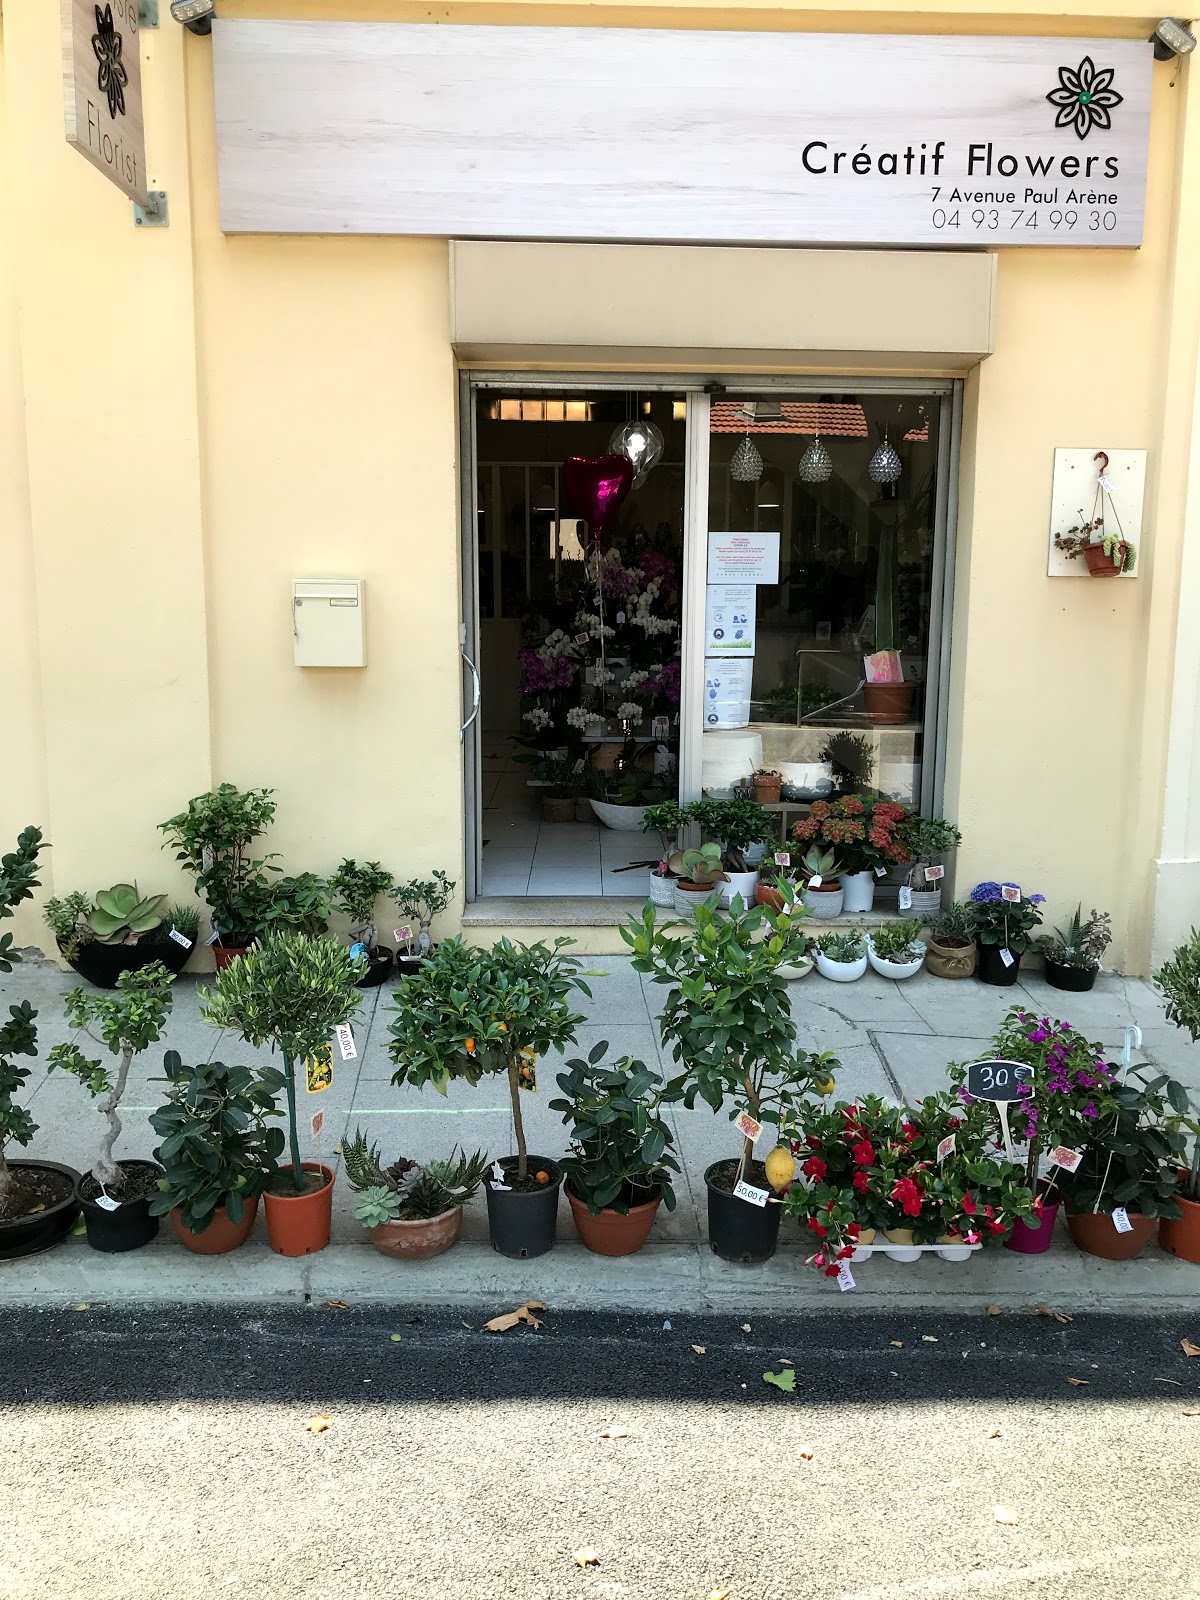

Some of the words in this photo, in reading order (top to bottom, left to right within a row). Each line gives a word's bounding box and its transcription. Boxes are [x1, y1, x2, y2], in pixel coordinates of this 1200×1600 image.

[87, 99, 138, 188] Florist
[801, 141, 945, 176] Créatif
[967, 142, 1119, 178] Flowers
[931, 187, 941, 203] 7
[949, 187, 1016, 204] Avenue
[1024, 187, 1058, 204] Paul
[1065, 188, 1118, 205] Arène
[932, 208, 961, 230] 04
[971, 209, 999, 231] 93
[1010, 210, 1039, 231] 74
[1049, 210, 1078, 231] 99
[1088, 211, 1117, 231] 30
[339, 1028, 352, 1051] 40,00
[980, 1066, 1009, 1091] 30
[1013, 1066, 1028, 1081] €
[736, 1185, 758, 1200] 50,00
